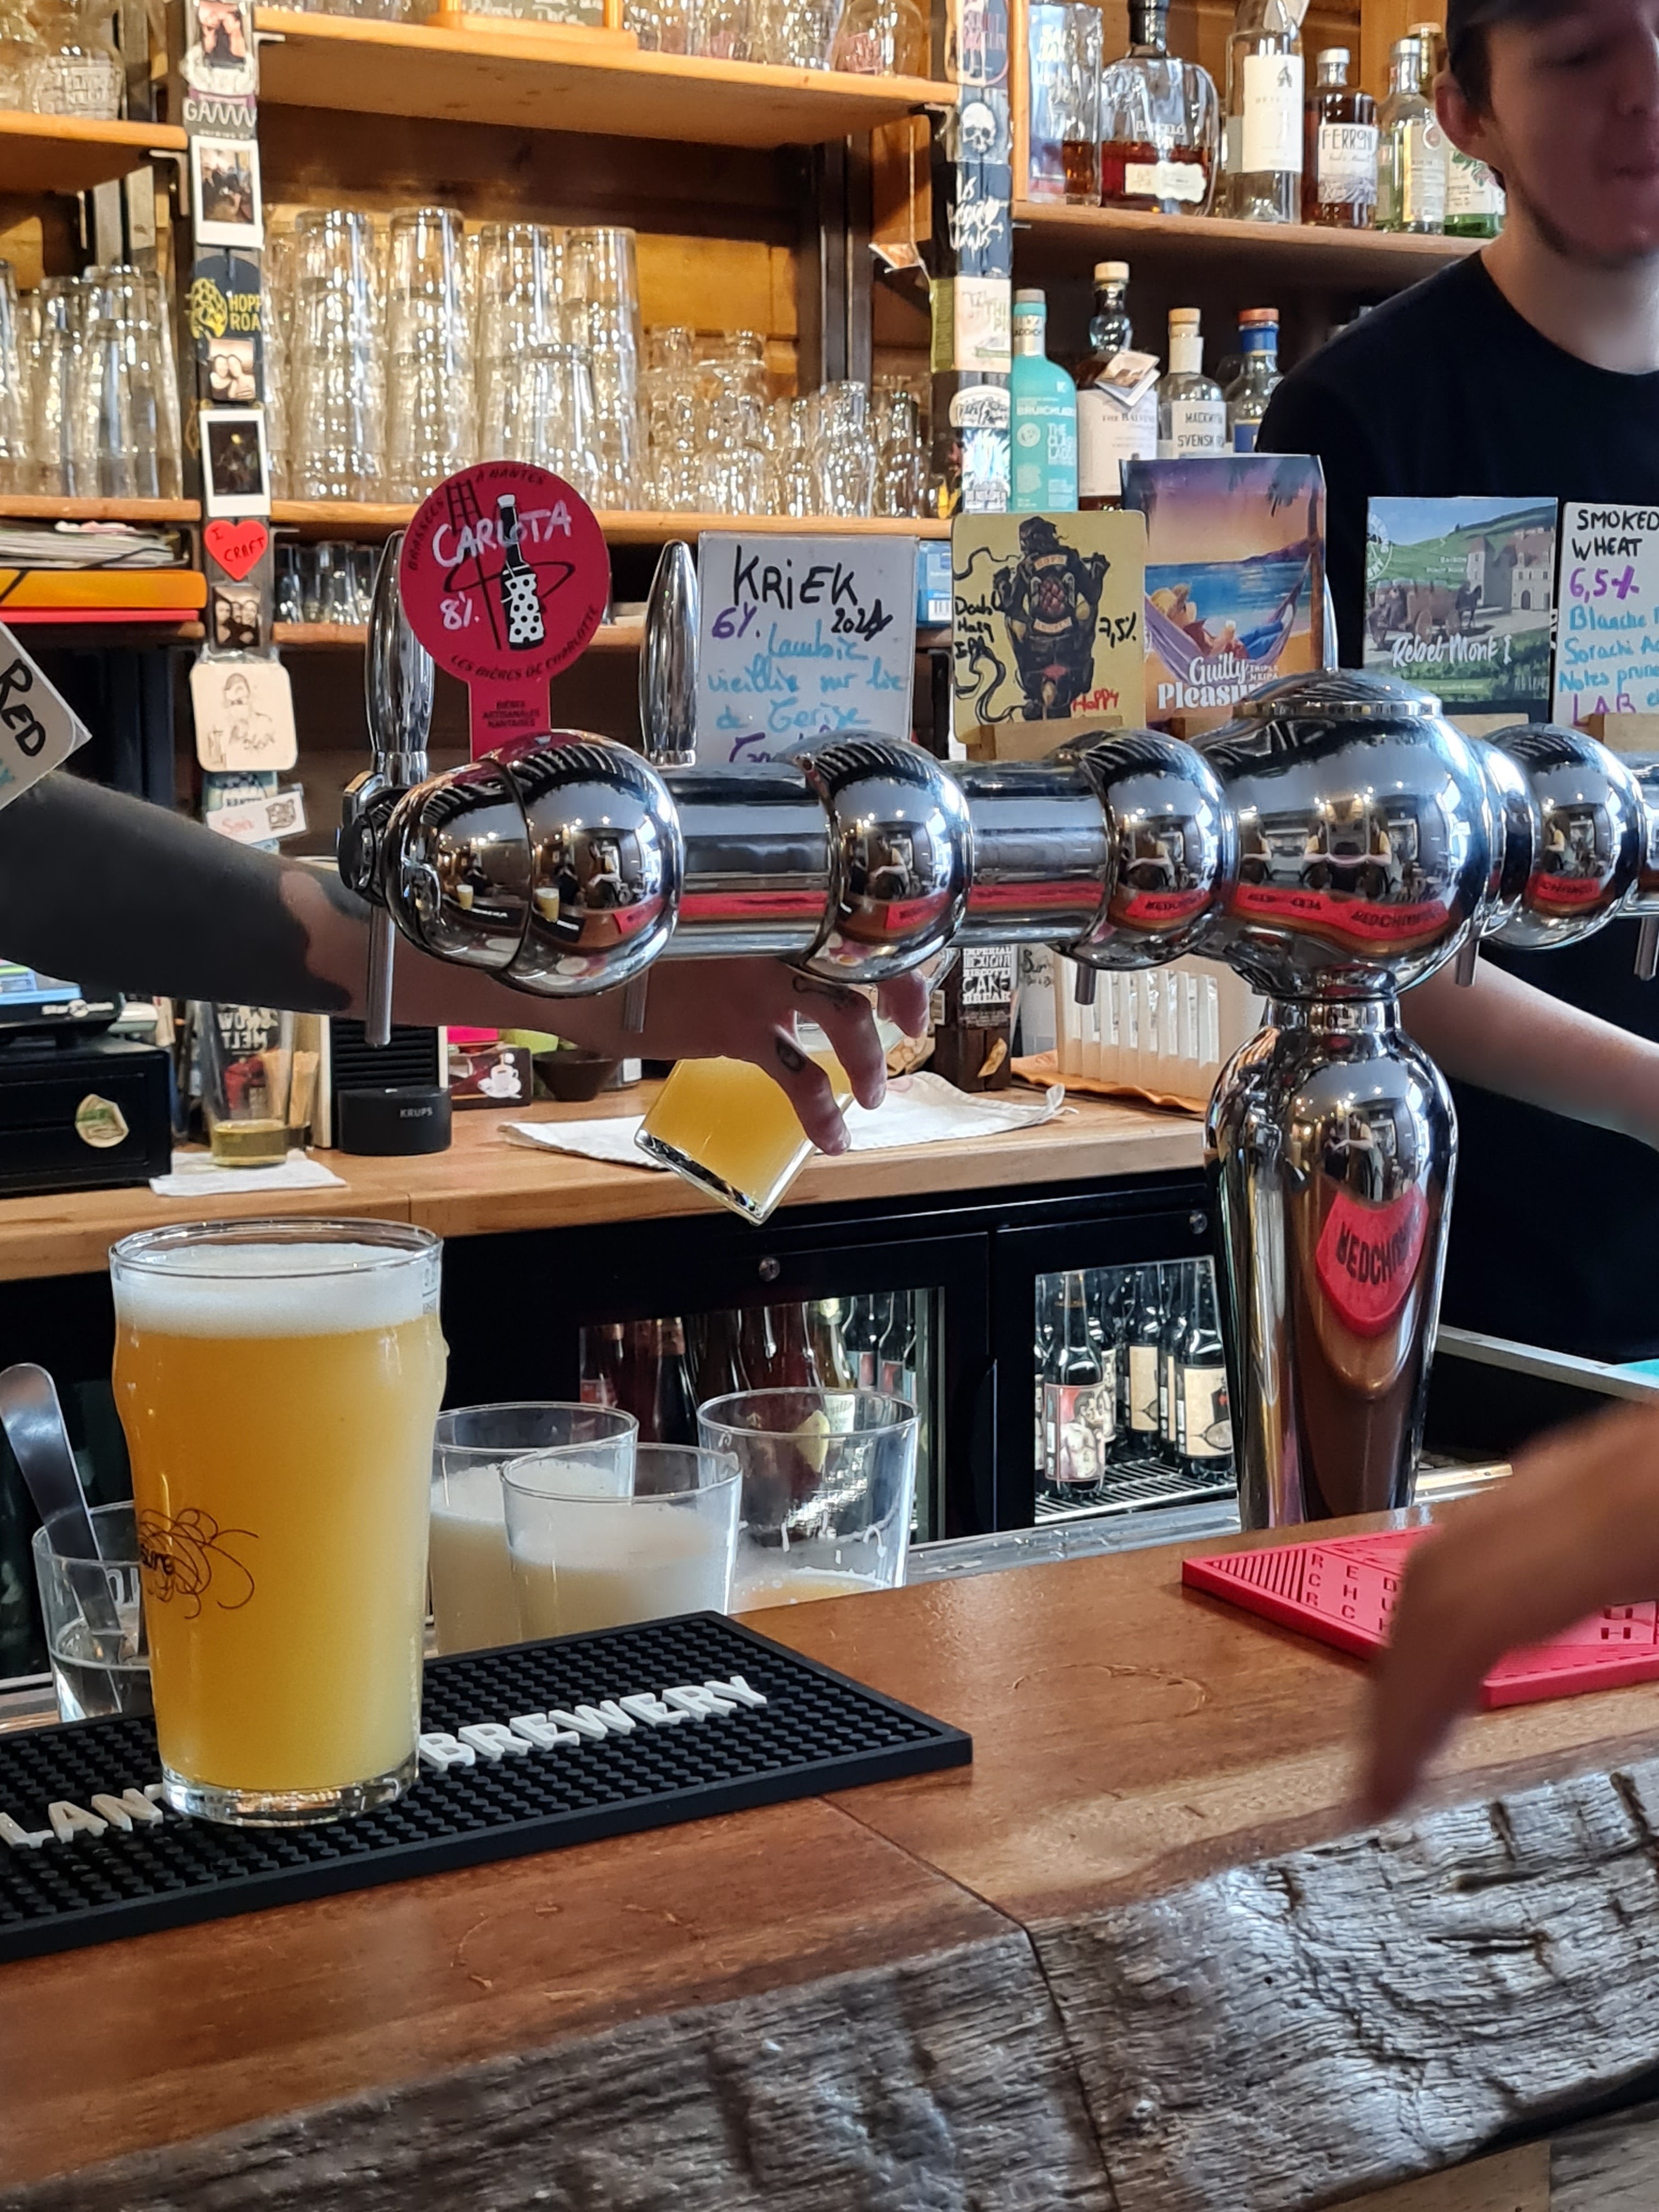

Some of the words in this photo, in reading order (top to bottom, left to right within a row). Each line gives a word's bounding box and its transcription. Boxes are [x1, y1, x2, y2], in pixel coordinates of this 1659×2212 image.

[229, 313, 262, 331] ROA
[211, 527, 224, 541] I
[432, 499, 572, 568] CARLOTA
[223, 536, 264, 562] CRAFT
[1572, 537, 1643, 561] WHEAT
[1570, 605, 1647, 630] Blanche
[1392, 634, 1444, 668] Rebel
[1449, 633, 1499, 664] Monk
[1564, 636, 1634, 665] Sorachi
[1189, 651, 1249, 685] Guilty
[0, 658, 46, 757] RED
[1158, 681, 1264, 709] Pleasu
[962, 992, 1012, 1005] BREAK
[963, 976, 1011, 994] CAKE
[399, 1106, 433, 1118] KRUPS
[419, 1675, 768, 1772] BREWERY
[0, 1783, 163, 1849] LAN
